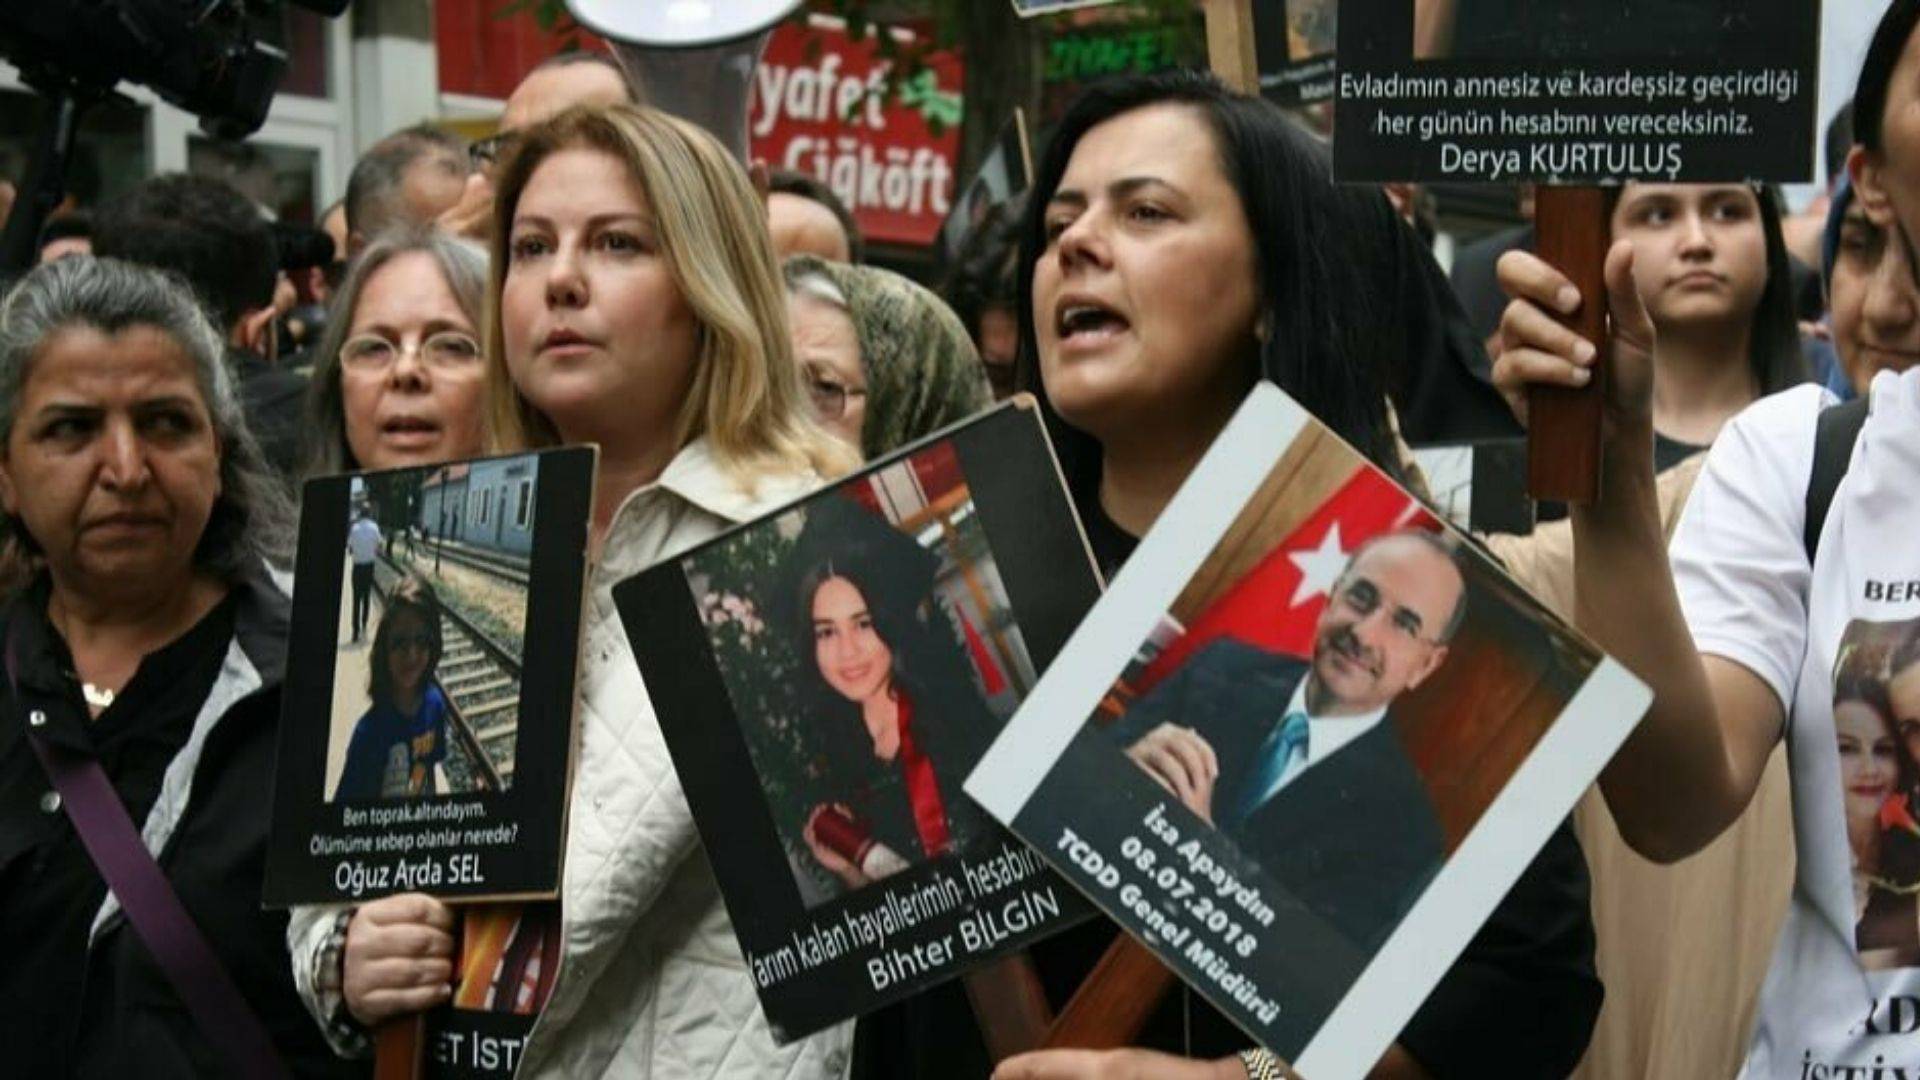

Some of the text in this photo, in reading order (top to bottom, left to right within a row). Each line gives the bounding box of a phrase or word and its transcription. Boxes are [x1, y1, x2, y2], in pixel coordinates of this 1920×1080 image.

[1340, 71, 1449, 98] Evladımın
[1453, 71, 1541, 98] annesiz
[1579, 69, 1687, 101] kardeşsiz
[1692, 69, 1799, 102] geçirdiği
[1377, 107, 1754, 141] her günün hesabını vereceksiniz.
[1440, 142, 1683, 181] Derya KURTULUŞ
[342, 807, 368, 827] Ben
[370, 803, 411, 828] toprak
[310, 822, 519, 856] Ölümüme sebep olanlar nerede?
[335, 853, 485, 897] Oğuz Arda SEL
[1143, 802, 1276, 927] İsa Apaydın
[1120, 835, 1258, 958] 08.07.2018
[793, 924, 849, 969] kalan
[867, 886, 1061, 991] Bihter BİLGİN
[1057, 827, 1281, 1026] TCDD Genel Müdürü
[472, 1029, 529, 1072] İST
